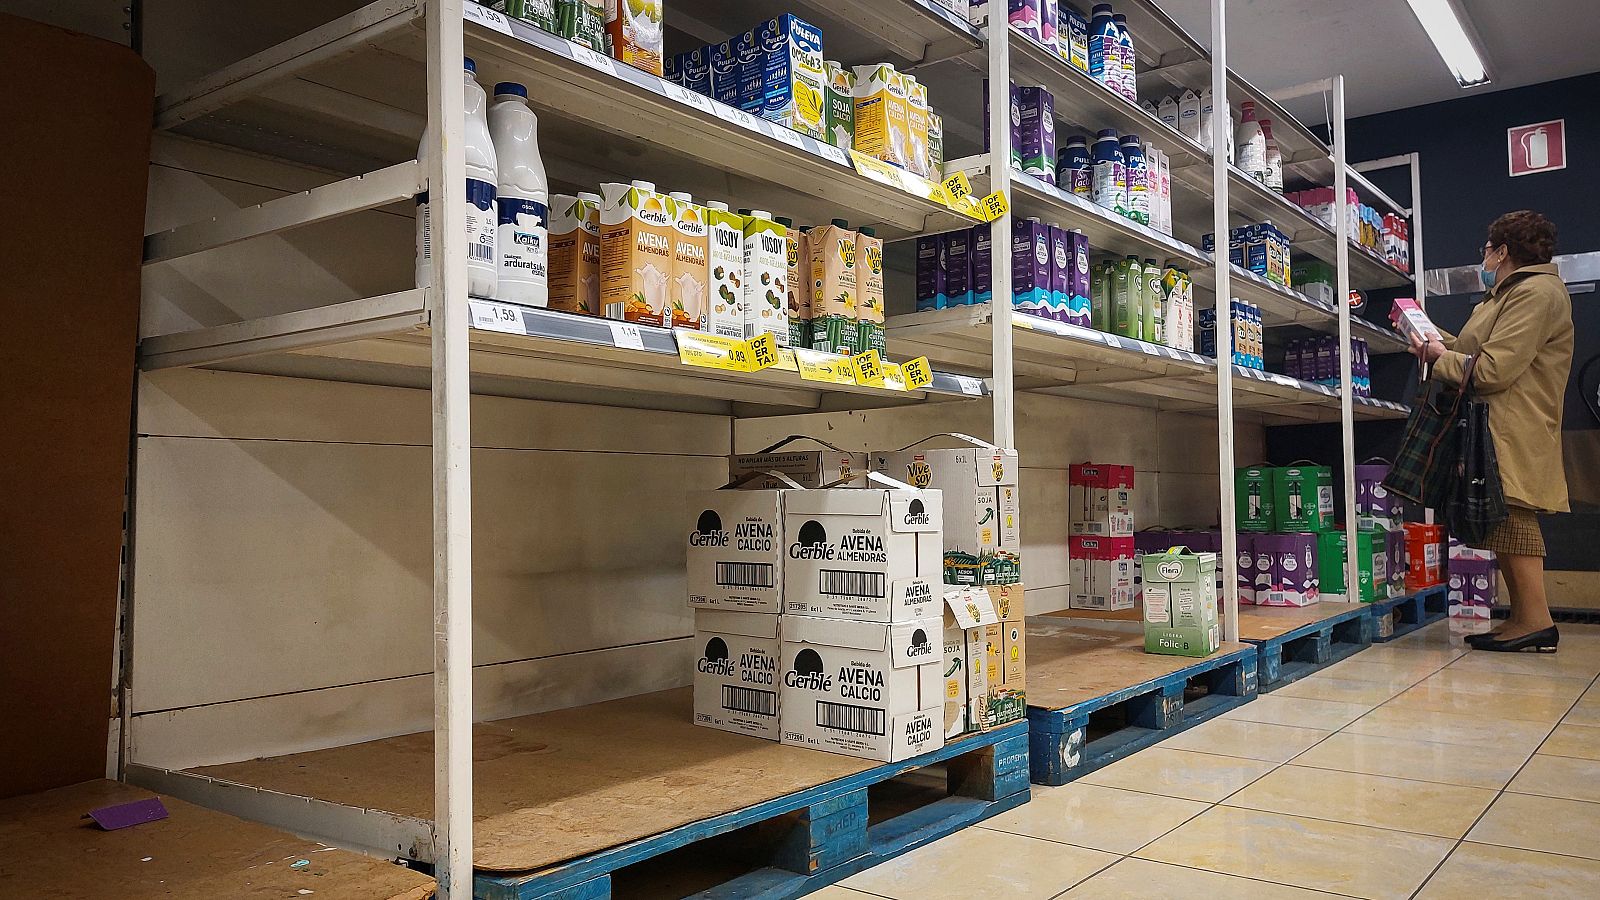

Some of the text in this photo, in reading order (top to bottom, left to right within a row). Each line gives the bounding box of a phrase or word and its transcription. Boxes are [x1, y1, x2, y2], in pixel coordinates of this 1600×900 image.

[791, 20, 821, 44] PULEVA
[833, 98, 850, 114] SOJA
[639, 209, 667, 227] Gerblé
[677, 220, 702, 237] Gerblé
[637, 231, 669, 252] AVENA
[715, 228, 739, 249] YOSOY
[761, 234, 783, 255] YOSOY
[637, 244, 670, 258] ALMENDRAS
[676, 242, 704, 261] AVENA
[675, 255, 705, 267] ALMENDRAS
[906, 463, 930, 480] Vive
[904, 512, 929, 526] Gerblé
[689, 529, 730, 548] Gerblé
[735, 523, 774, 541] AVENA
[737, 538, 772, 552] CALCIO
[789, 542, 835, 562] Gerblé
[840, 535, 884, 552] AVENA
[836, 551, 888, 563] ALMENDRAS
[905, 584, 931, 599] AVENA
[906, 642, 932, 658] Gerblé
[943, 645, 961, 654] SOJA
[697, 657, 736, 677] Gerblé
[739, 654, 776, 673] AVENA
[741, 671, 773, 686] CALCIO
[784, 670, 832, 692] Gerblé
[838, 667, 885, 688] AVENA
[840, 684, 881, 702] CALCIO
[905, 717, 932, 736] AVENA
[907, 731, 931, 746] CALCIO
